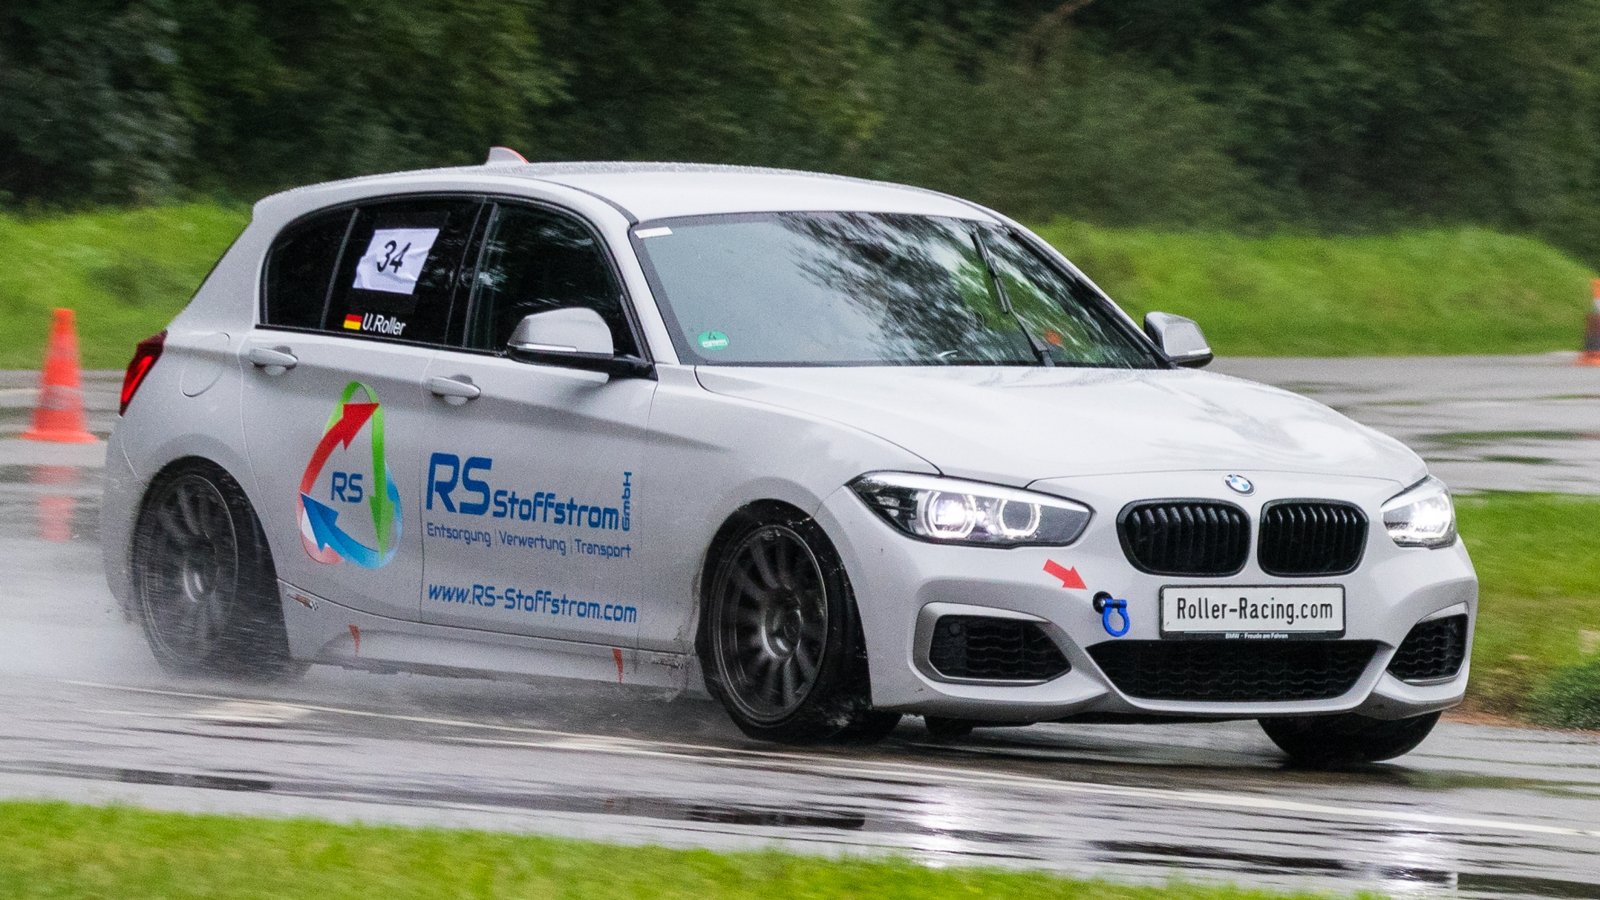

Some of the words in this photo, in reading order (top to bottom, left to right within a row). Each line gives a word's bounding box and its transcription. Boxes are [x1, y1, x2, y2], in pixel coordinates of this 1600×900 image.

[376, 240, 412, 274] 34
[362, 312, 407, 336] U.Roller
[330, 471, 363, 503] RS
[426, 452, 493, 516] RS
[492, 489, 620, 530] Stoffstrom
[621, 471, 633, 532] GmbH
[426, 522, 492, 546] Entsorgung
[499, 530, 567, 556] Verwertung
[574, 538, 632, 559] Transport
[428, 583, 637, 623] www.RS-Stoffstrom.com
[1176, 597, 1333, 625] Roller-Racing.com
